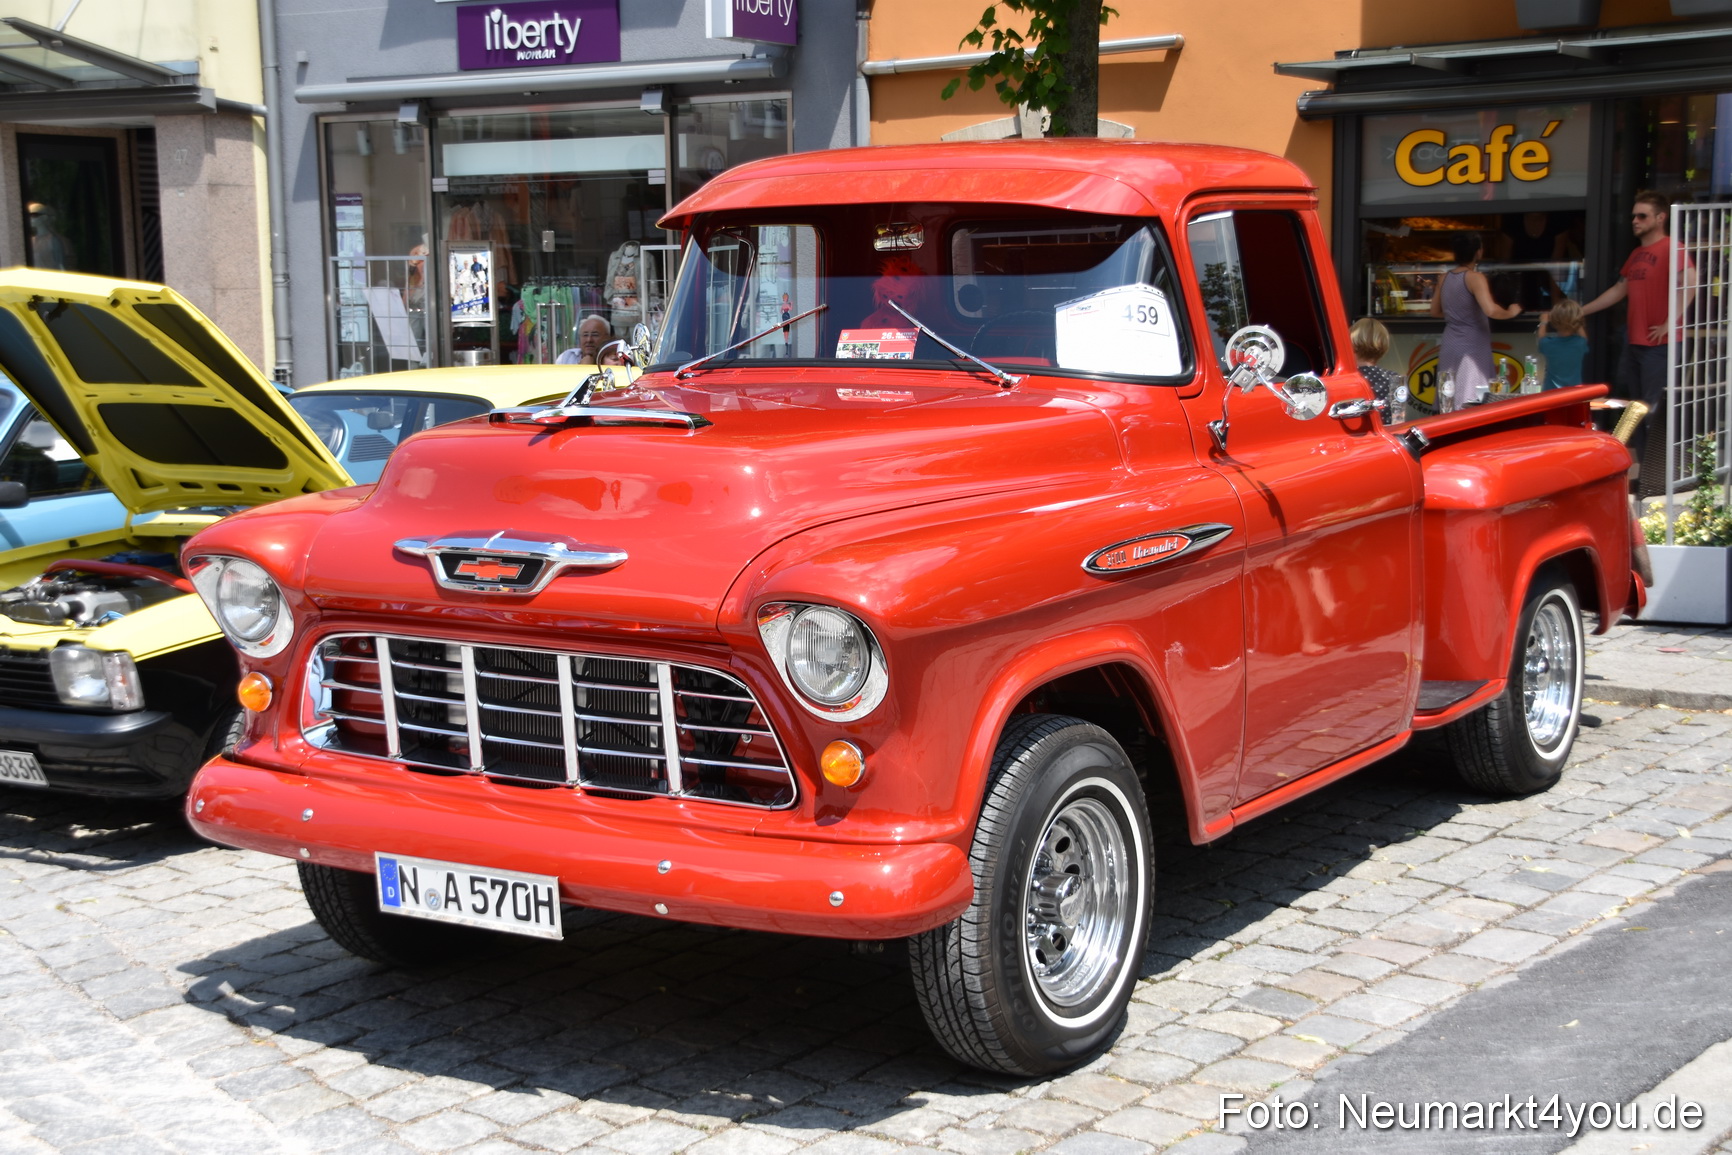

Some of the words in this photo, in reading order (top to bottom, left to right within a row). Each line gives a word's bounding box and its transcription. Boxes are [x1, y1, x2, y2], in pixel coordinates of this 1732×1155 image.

[484, 9, 582, 54] liberty
[736, 0, 794, 25] erty
[516, 48, 556, 61] woman
[1394, 119, 1563, 187] Café
[399, 864, 420, 905] N
[444, 872, 462, 911] A
[469, 875, 555, 926] 570H
